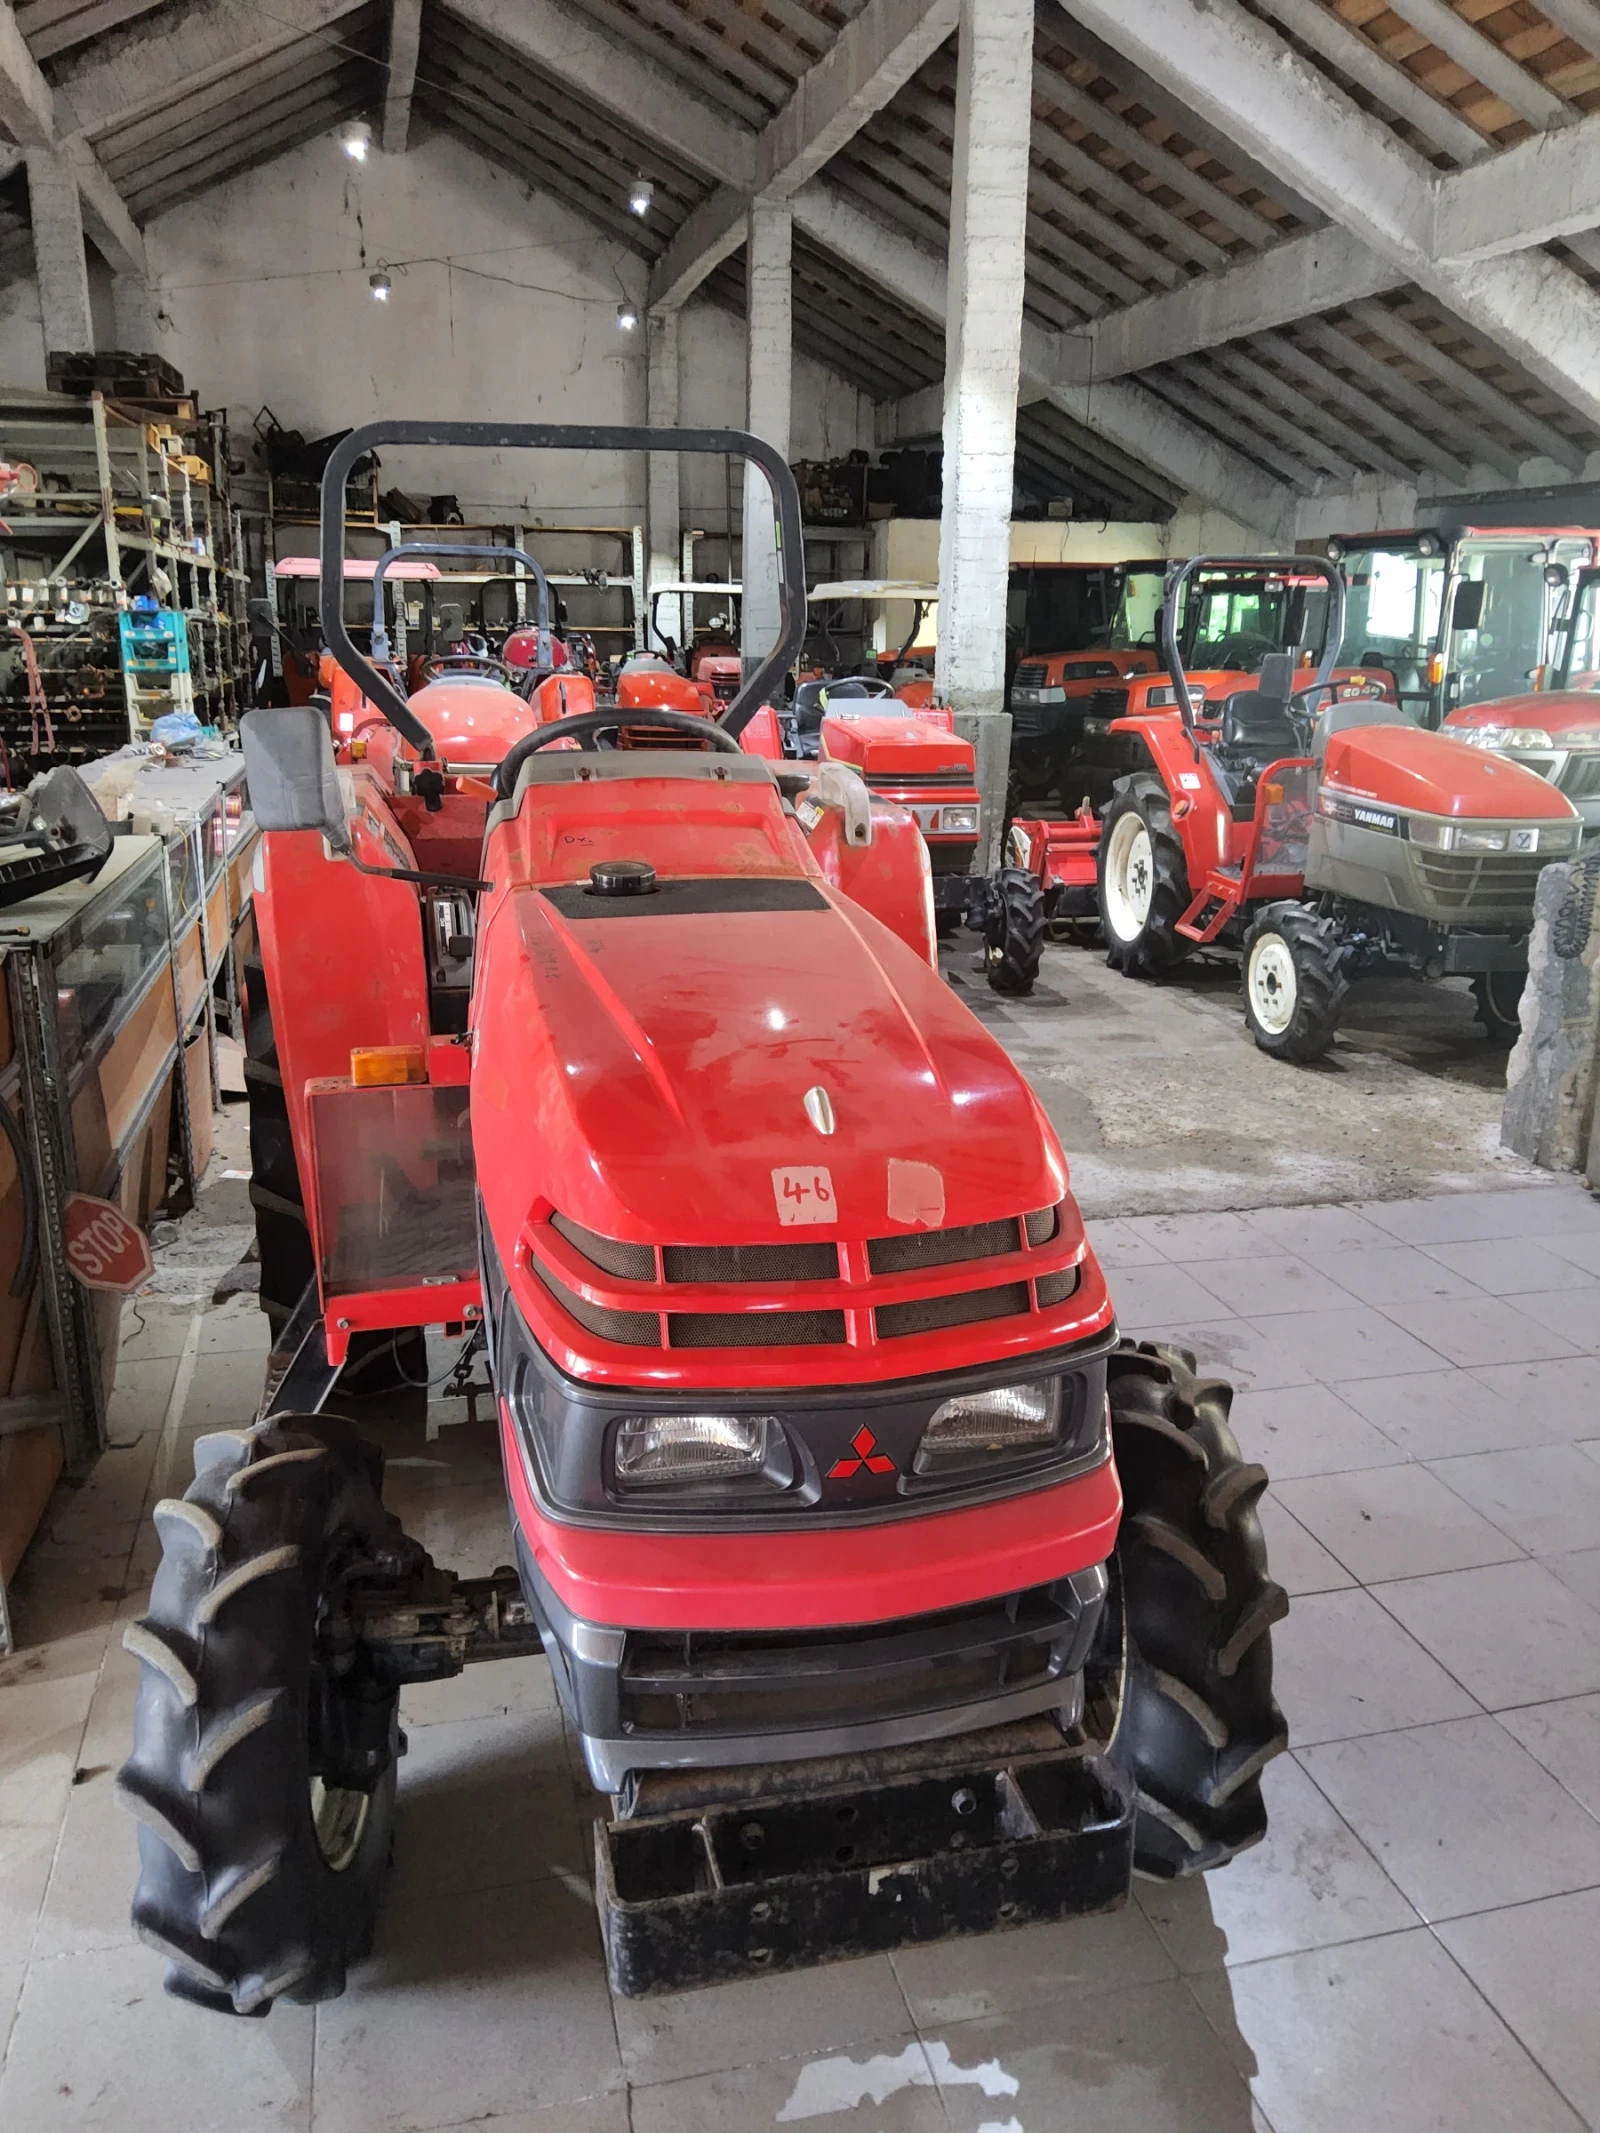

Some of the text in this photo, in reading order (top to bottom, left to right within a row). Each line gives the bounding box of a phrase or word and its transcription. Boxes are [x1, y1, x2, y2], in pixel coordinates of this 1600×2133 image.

[1354, 808, 1395, 829] YANMAR
[783, 1176, 830, 1204] 46
[68, 1210, 132, 1275] STOP
